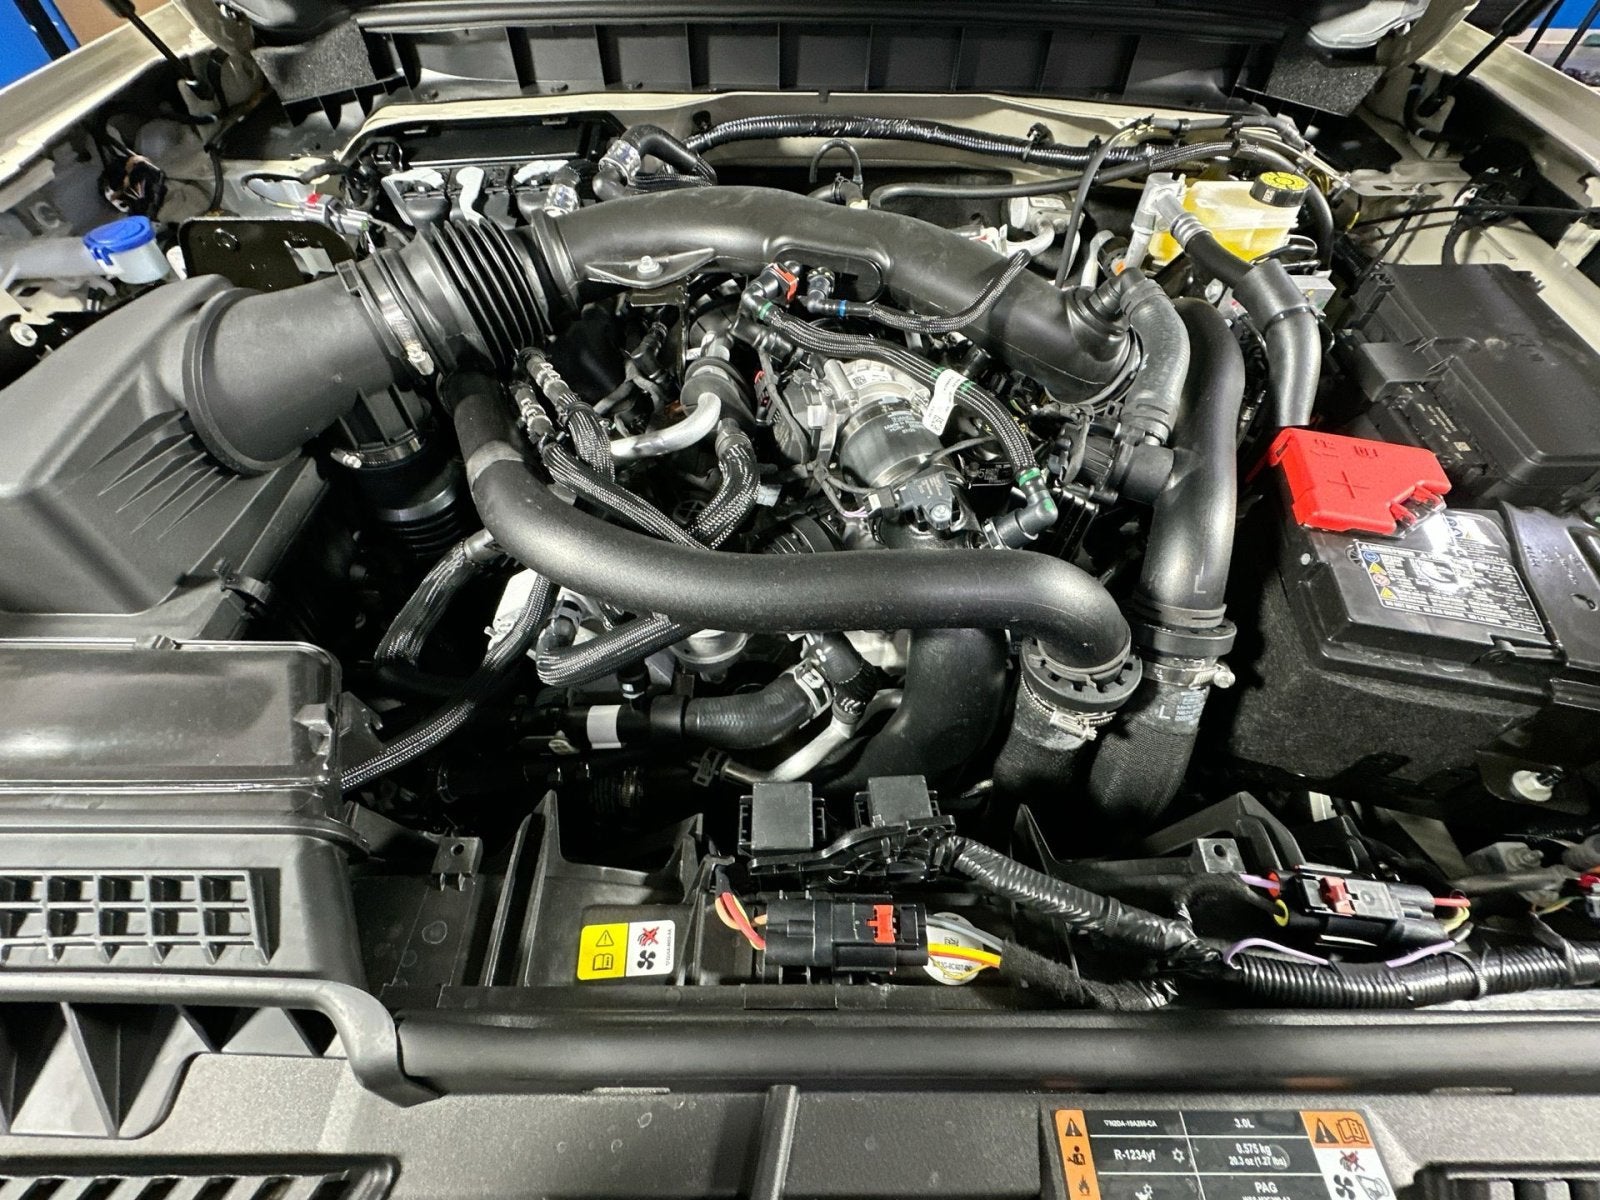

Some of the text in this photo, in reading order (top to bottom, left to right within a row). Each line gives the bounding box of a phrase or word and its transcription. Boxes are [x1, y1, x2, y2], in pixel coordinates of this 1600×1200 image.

[1194, 574, 1207, 594] L
[1159, 704, 1171, 720] L
[1234, 1117, 1255, 1129] 3.0L
[1113, 1149, 1156, 1163] R-1234yf
[1235, 1142, 1273, 1156] 0.575 kg
[1254, 1181, 1278, 1193] PAG
